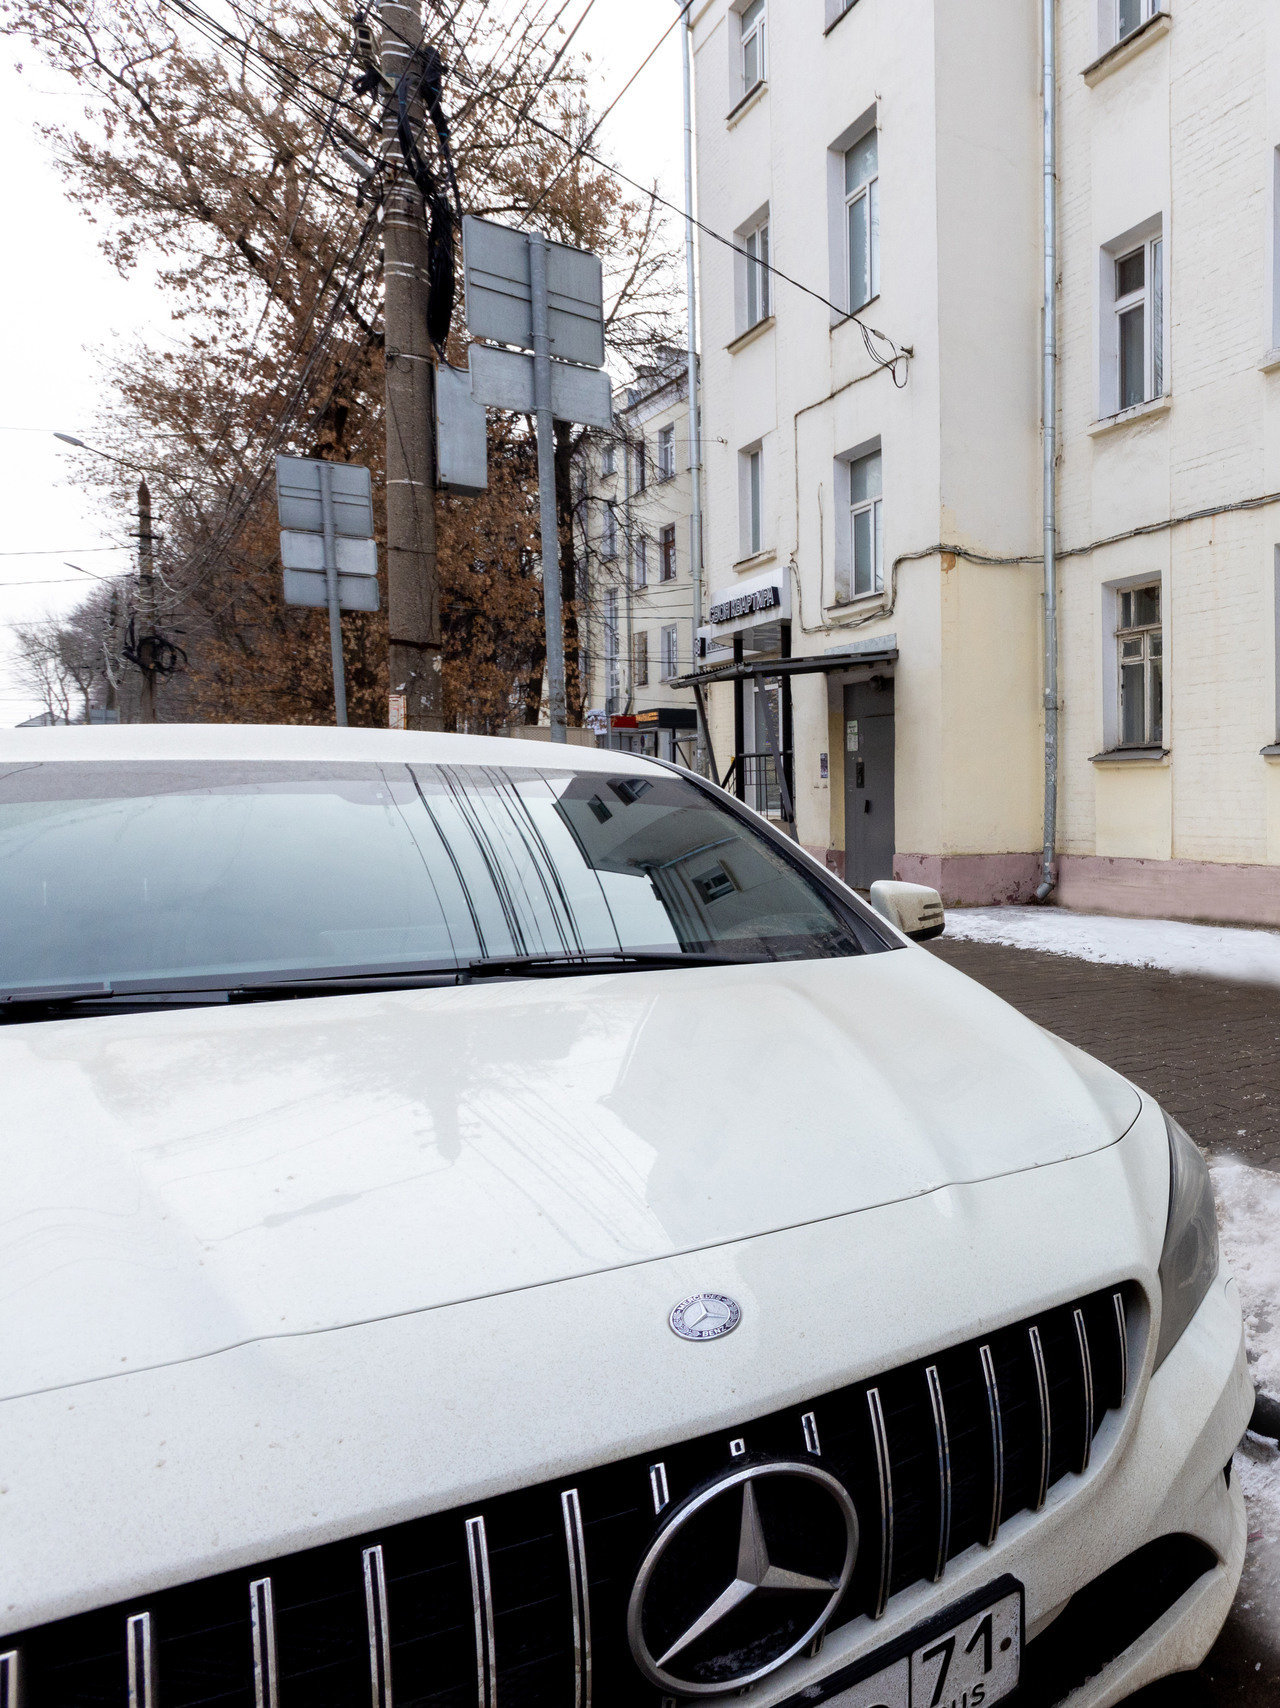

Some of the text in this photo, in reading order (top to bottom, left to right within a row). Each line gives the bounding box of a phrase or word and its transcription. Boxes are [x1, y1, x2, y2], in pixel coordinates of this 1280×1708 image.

[731, 586, 777, 618] КВАРТИРА
[702, 1325, 728, 1338] BENZ
[922, 1612, 993, 1708] 71
